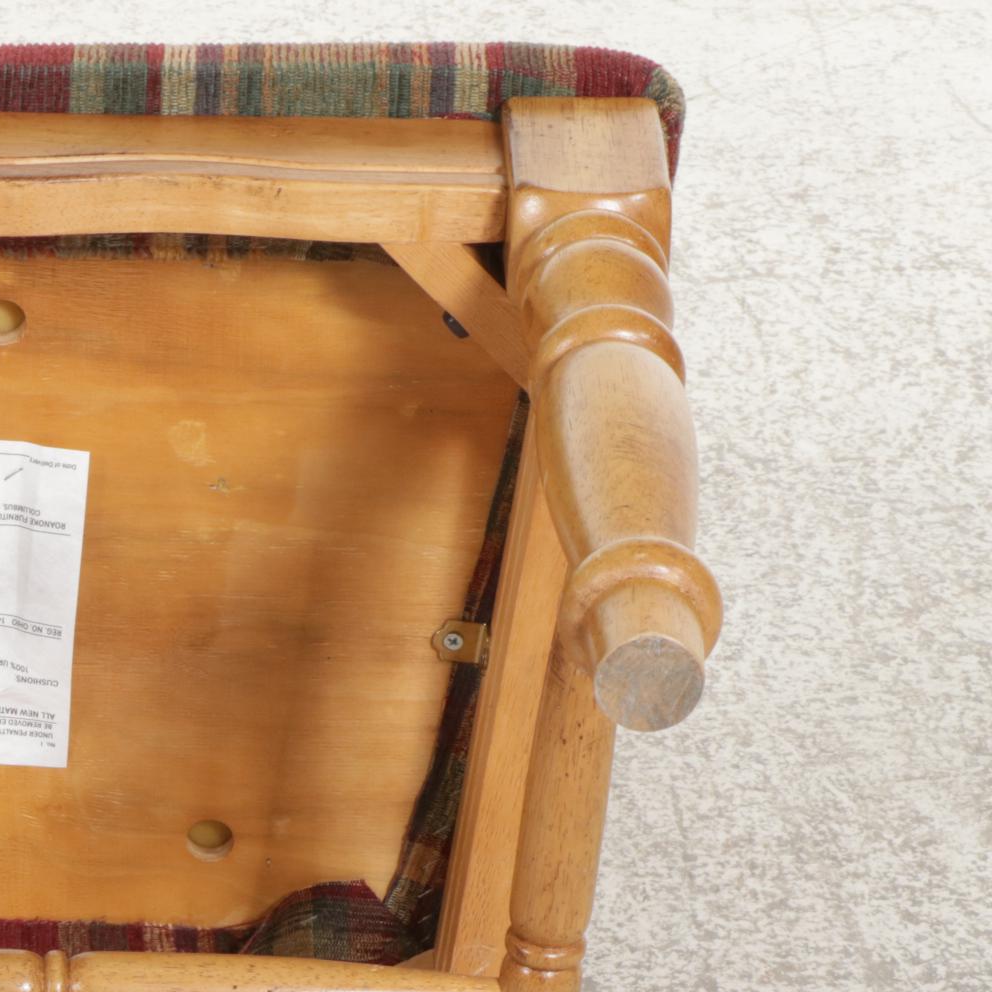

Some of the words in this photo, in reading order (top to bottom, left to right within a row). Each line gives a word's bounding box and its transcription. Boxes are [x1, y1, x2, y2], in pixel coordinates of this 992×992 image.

[29, 457, 53, 468] Delivery
[30, 518, 66, 530] ROANOKE
[12, 618, 28, 630] OHIO
[45, 627, 62, 636] REG.
[10, 662, 28, 673] 100%
[8, 719, 42, 728] REMOVED
